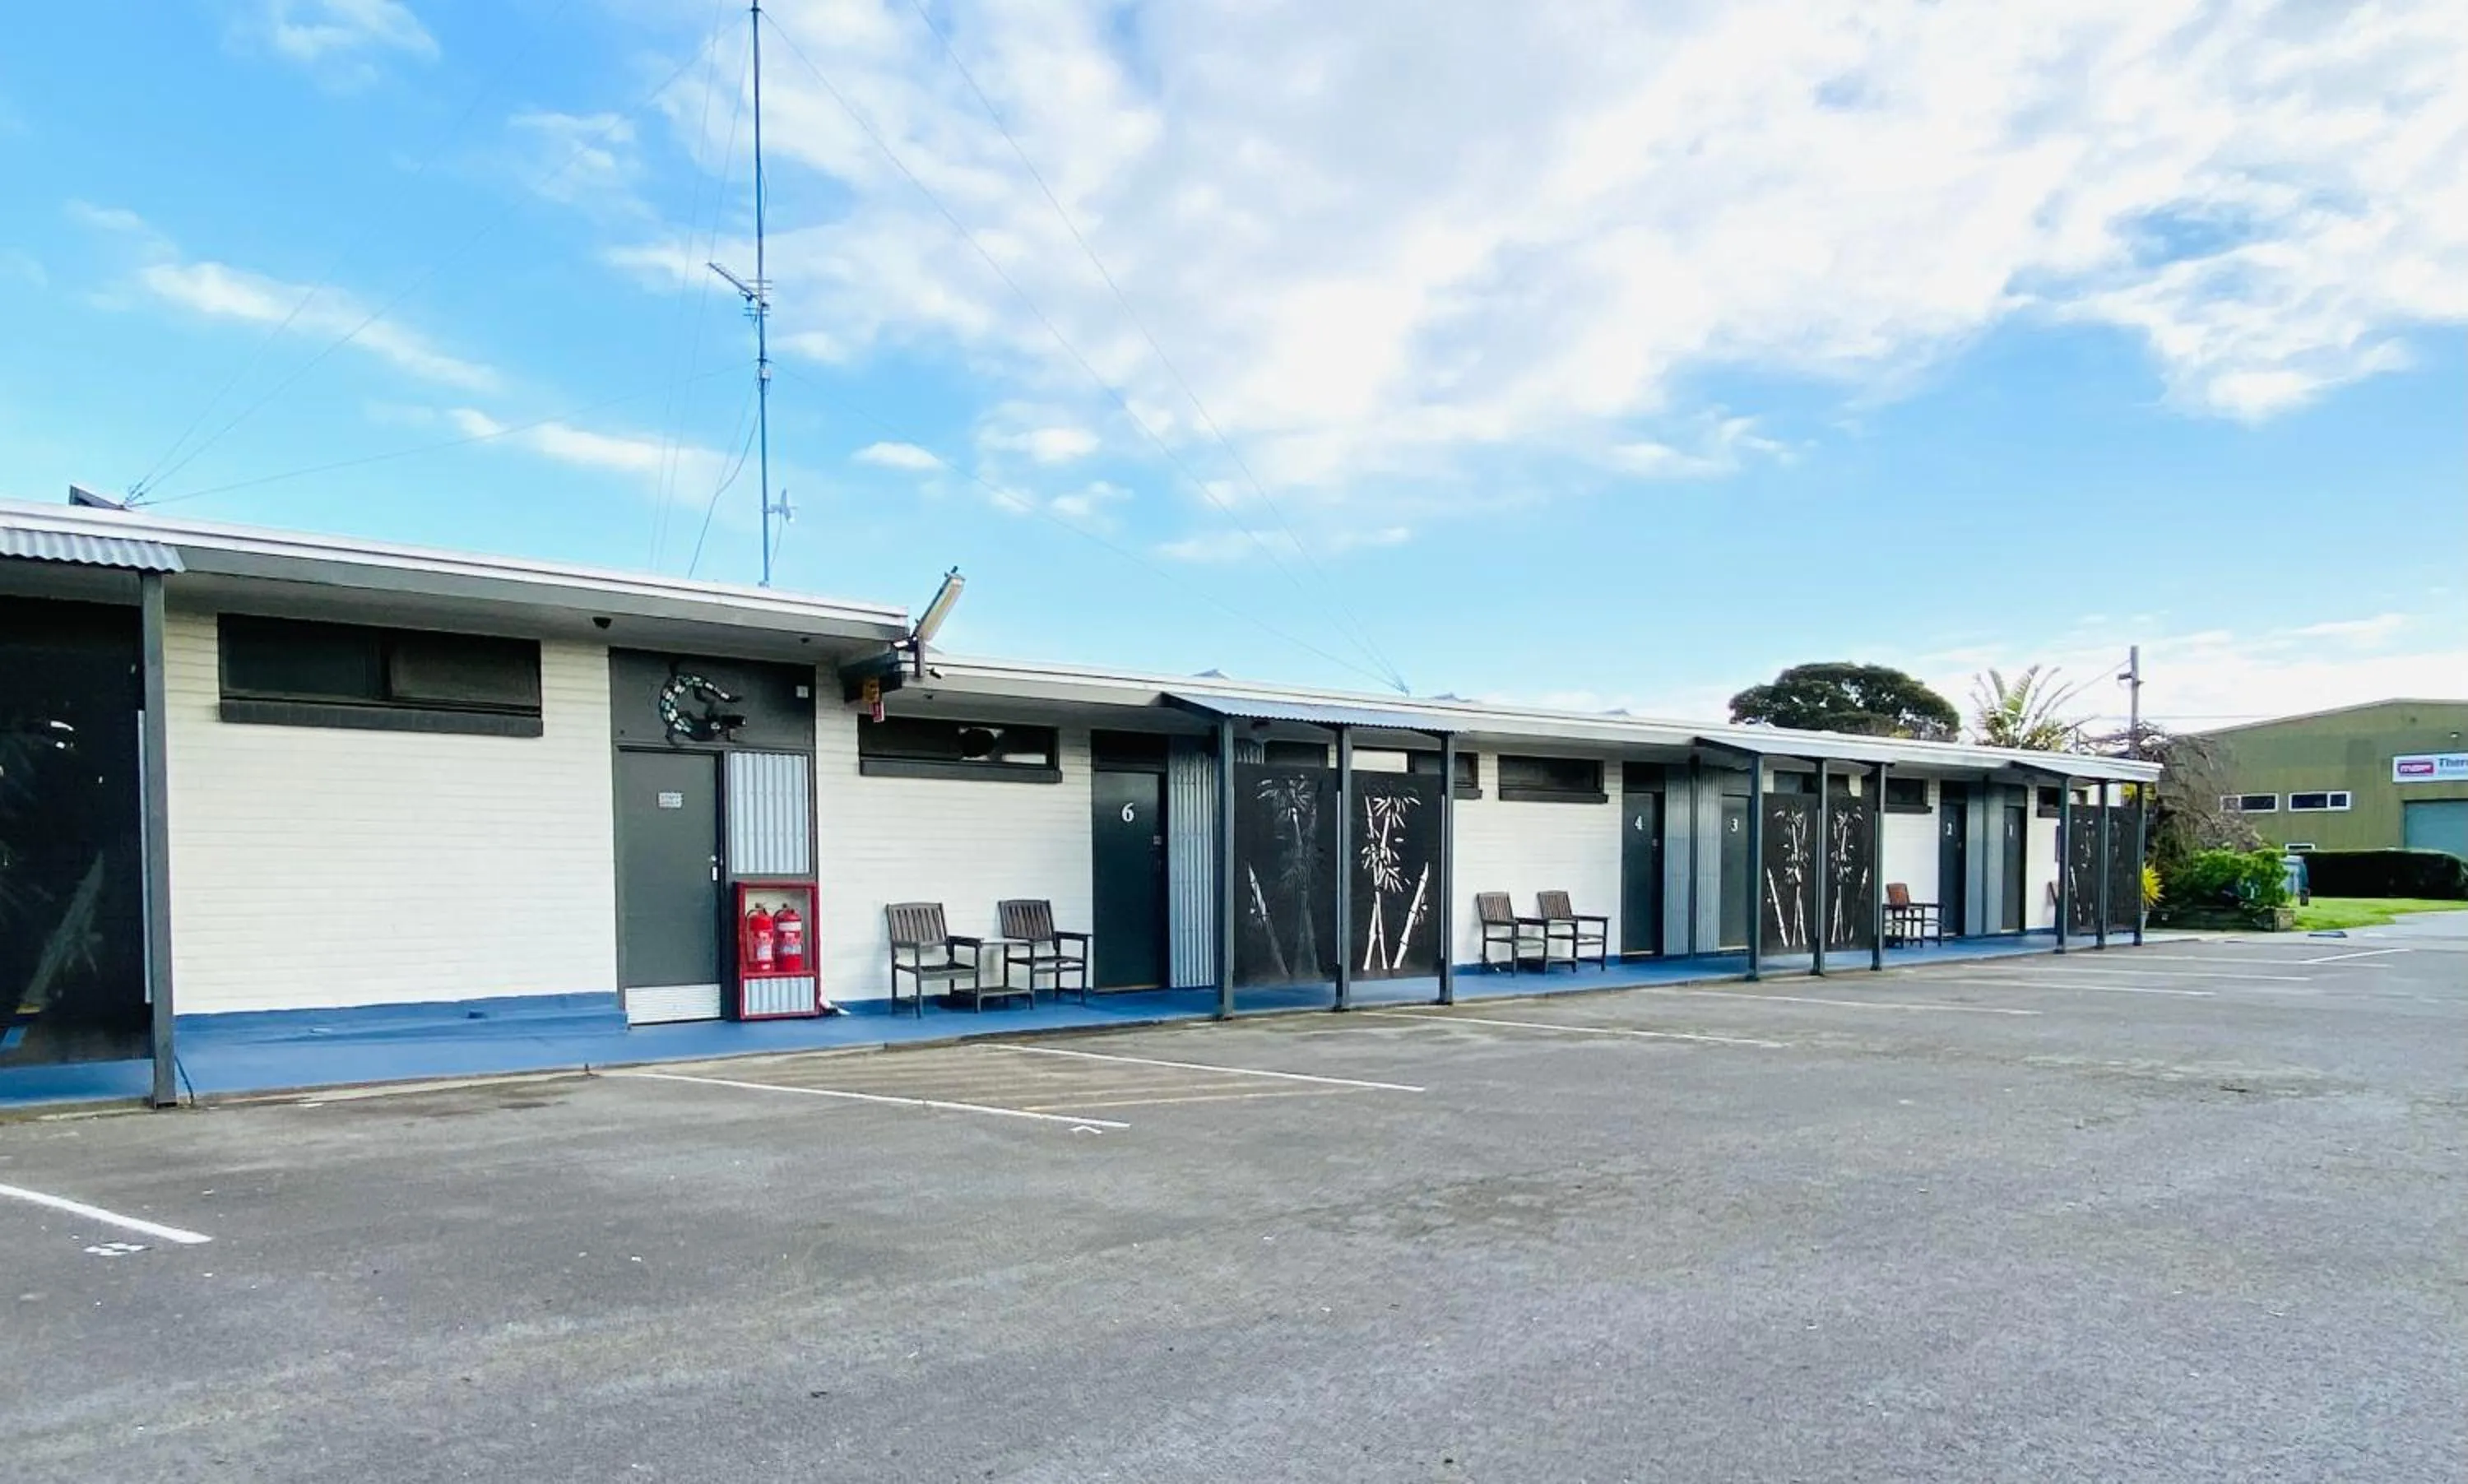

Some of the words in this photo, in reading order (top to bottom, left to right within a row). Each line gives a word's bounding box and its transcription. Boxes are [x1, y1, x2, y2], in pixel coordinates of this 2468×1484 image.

[1121, 802, 1134, 822] 6
[1634, 815, 1643, 830] 4
[1730, 818, 1738, 832] 3
